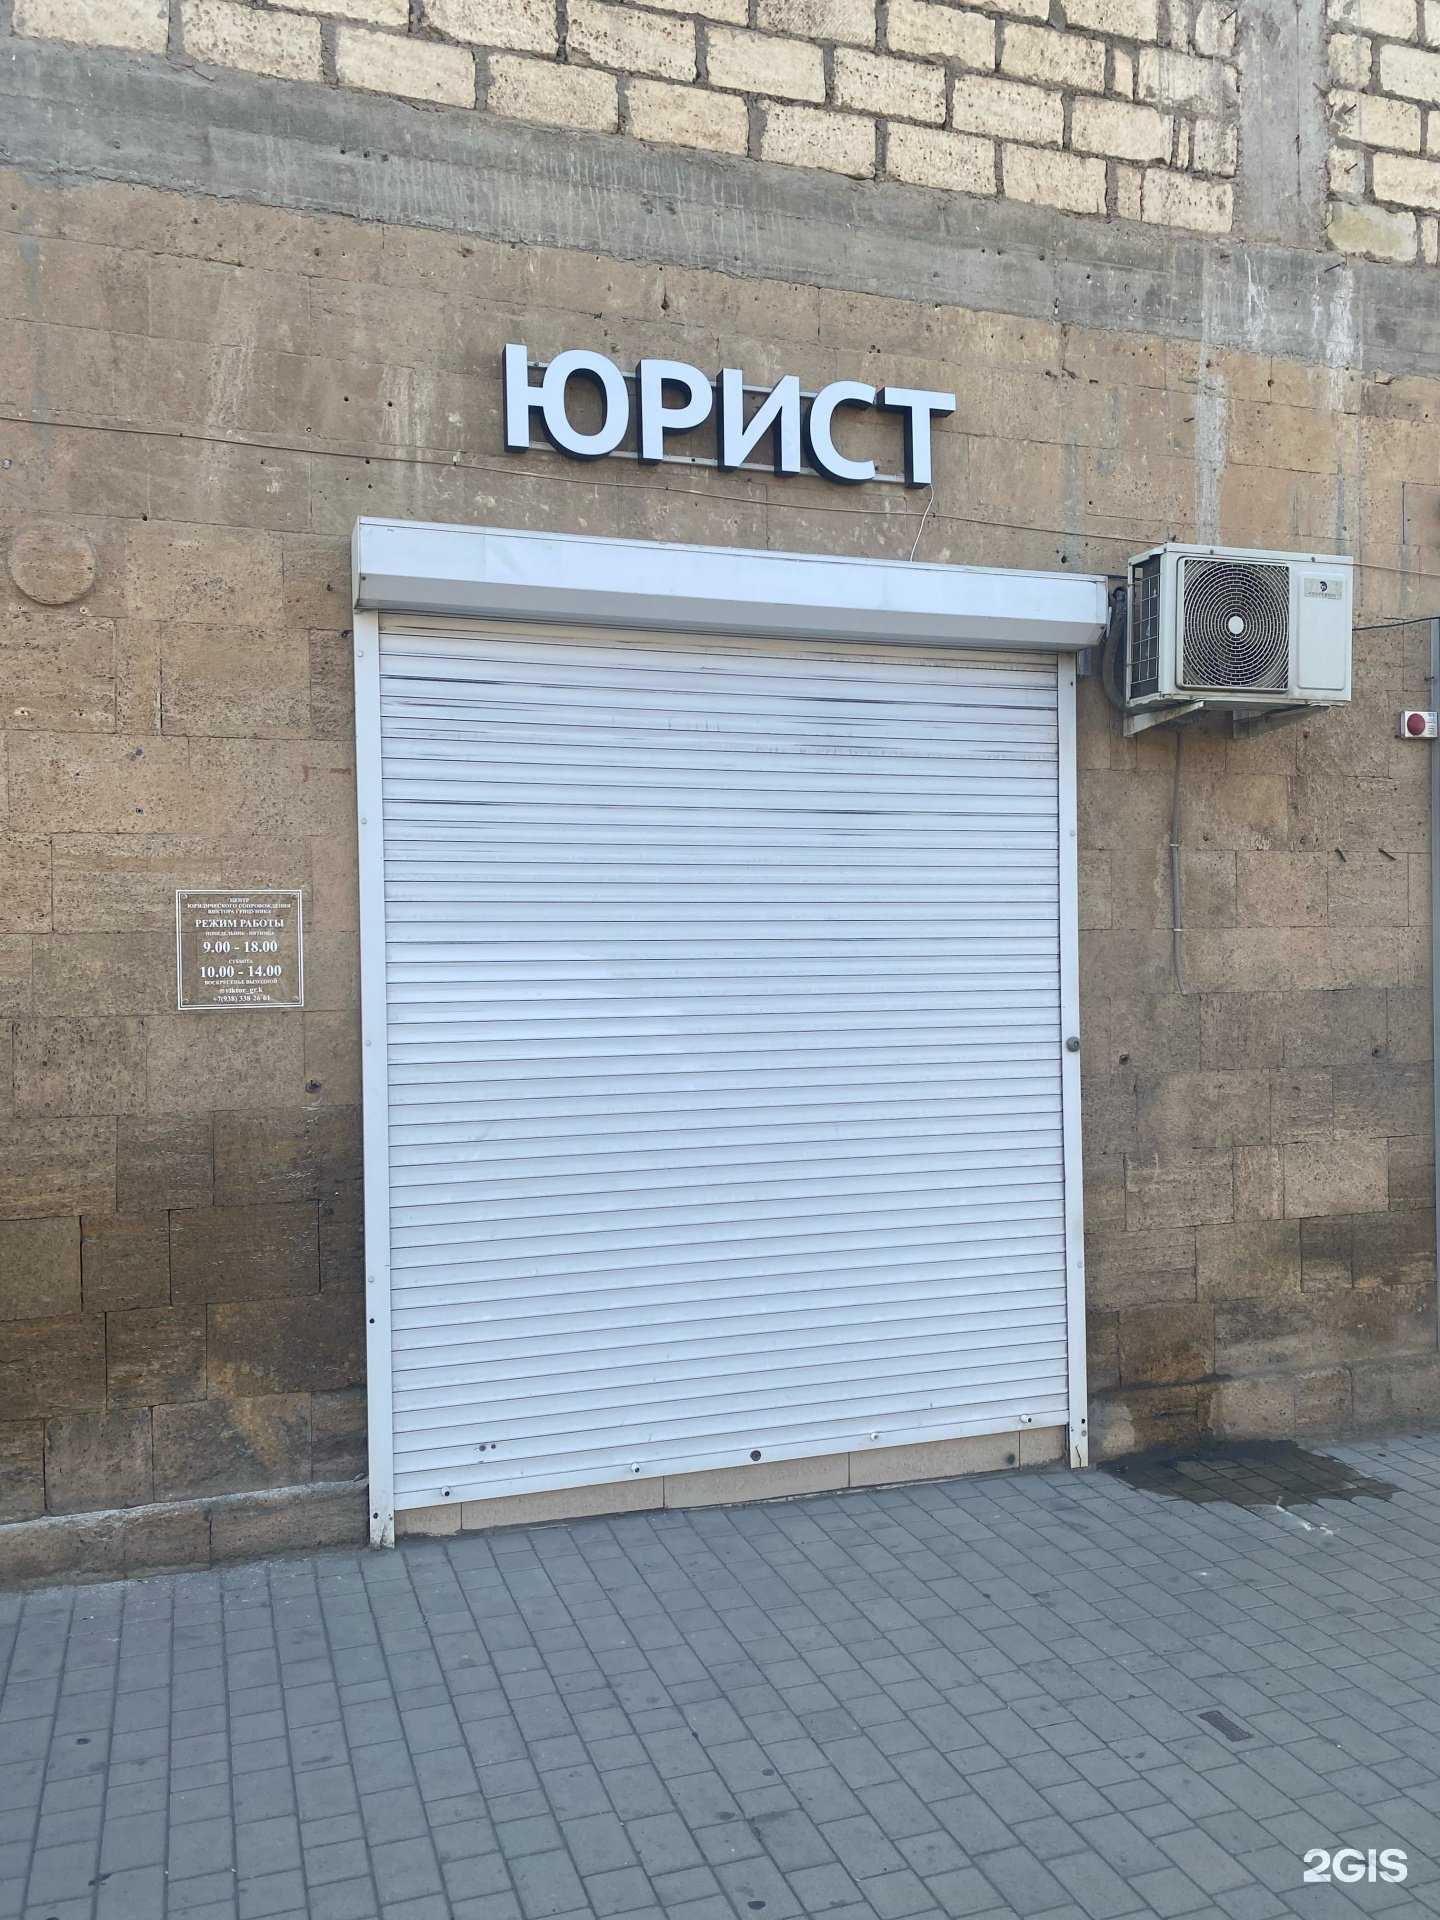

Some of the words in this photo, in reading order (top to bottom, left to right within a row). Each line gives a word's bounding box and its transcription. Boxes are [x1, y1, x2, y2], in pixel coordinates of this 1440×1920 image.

[502, 343, 957, 489] ЮРИСТ
[195, 919, 237, 928] РЕЖИМ
[240, 918, 284, 927] РАБОТЫ
[203, 941, 231, 953] 9.00
[245, 940, 278, 953] 18.00
[200, 966, 235, 978] 10.00
[248, 965, 282, 977] 14.00
